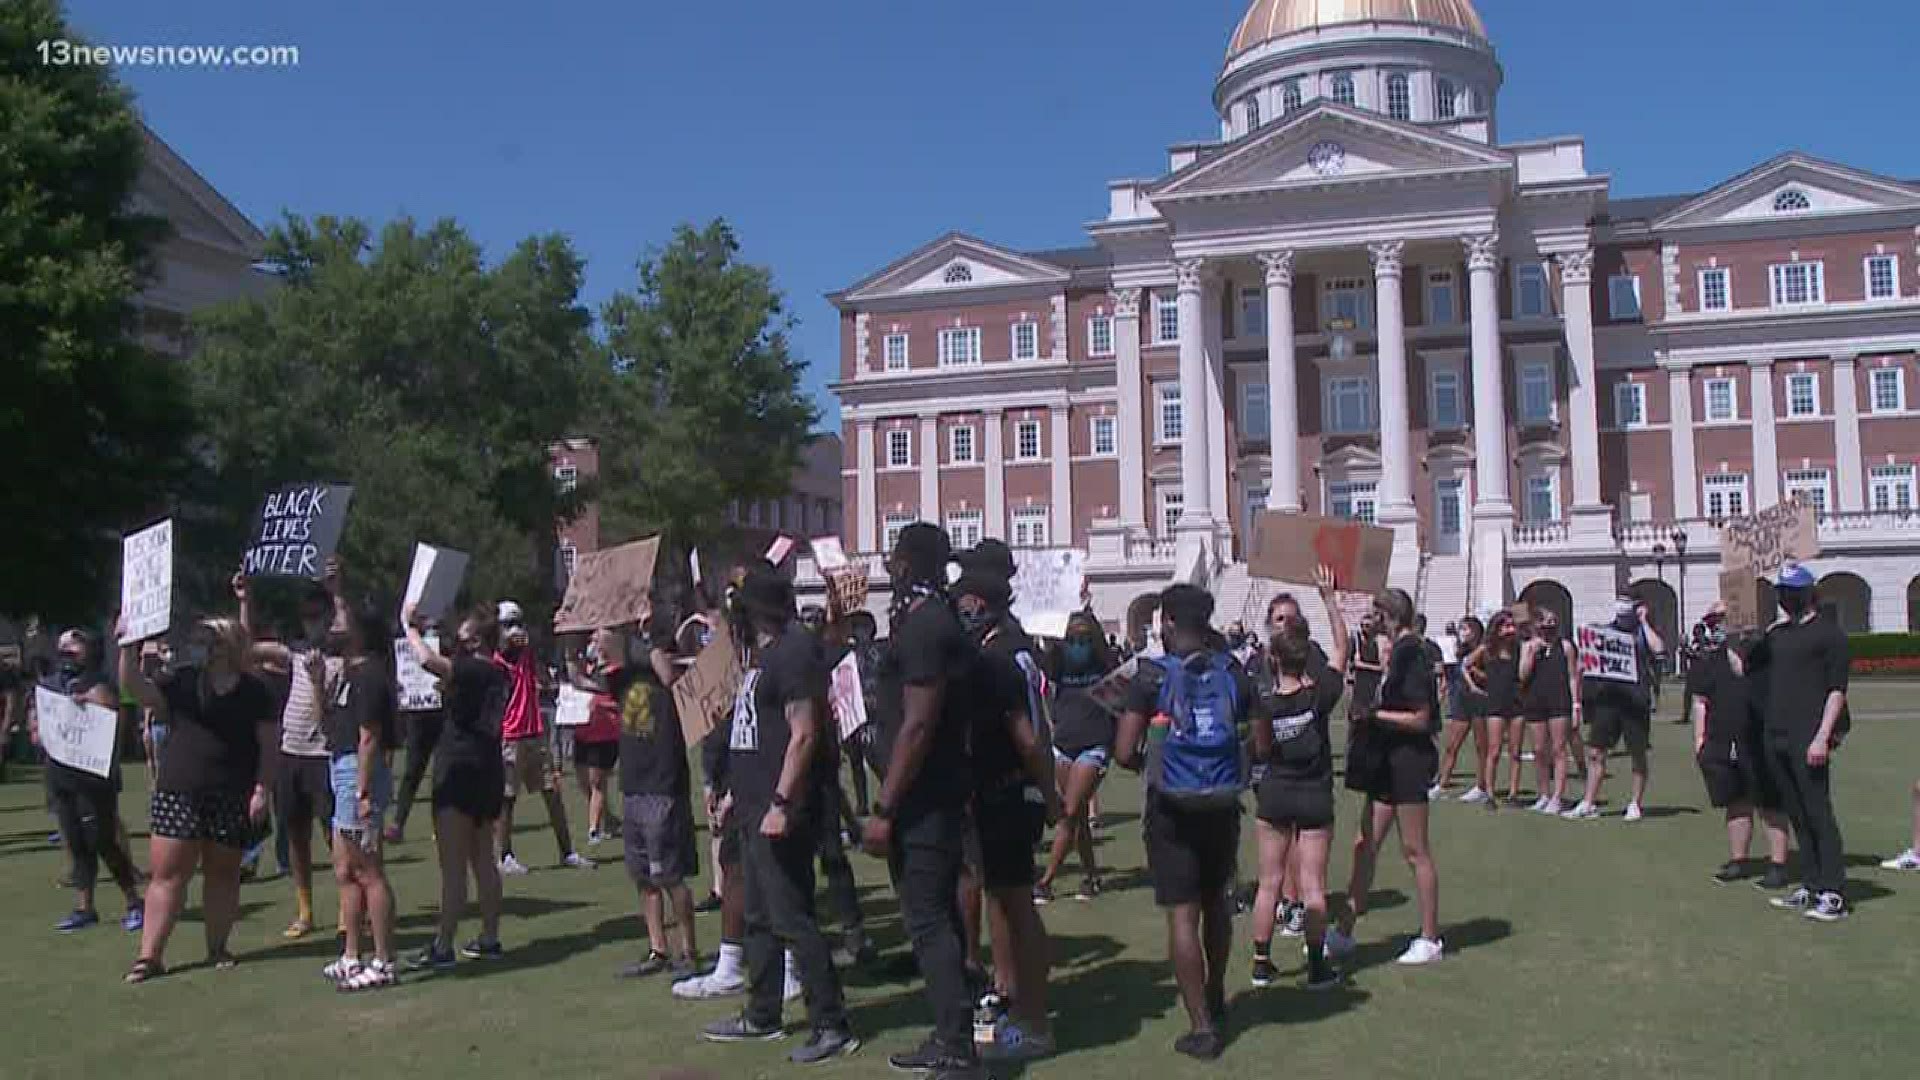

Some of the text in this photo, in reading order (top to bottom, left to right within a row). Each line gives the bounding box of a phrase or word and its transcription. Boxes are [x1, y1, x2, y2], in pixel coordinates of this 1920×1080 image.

[264, 486, 328, 518] BLACK
[261, 517, 313, 542] LIVES
[242, 544, 318, 575] MATTER
